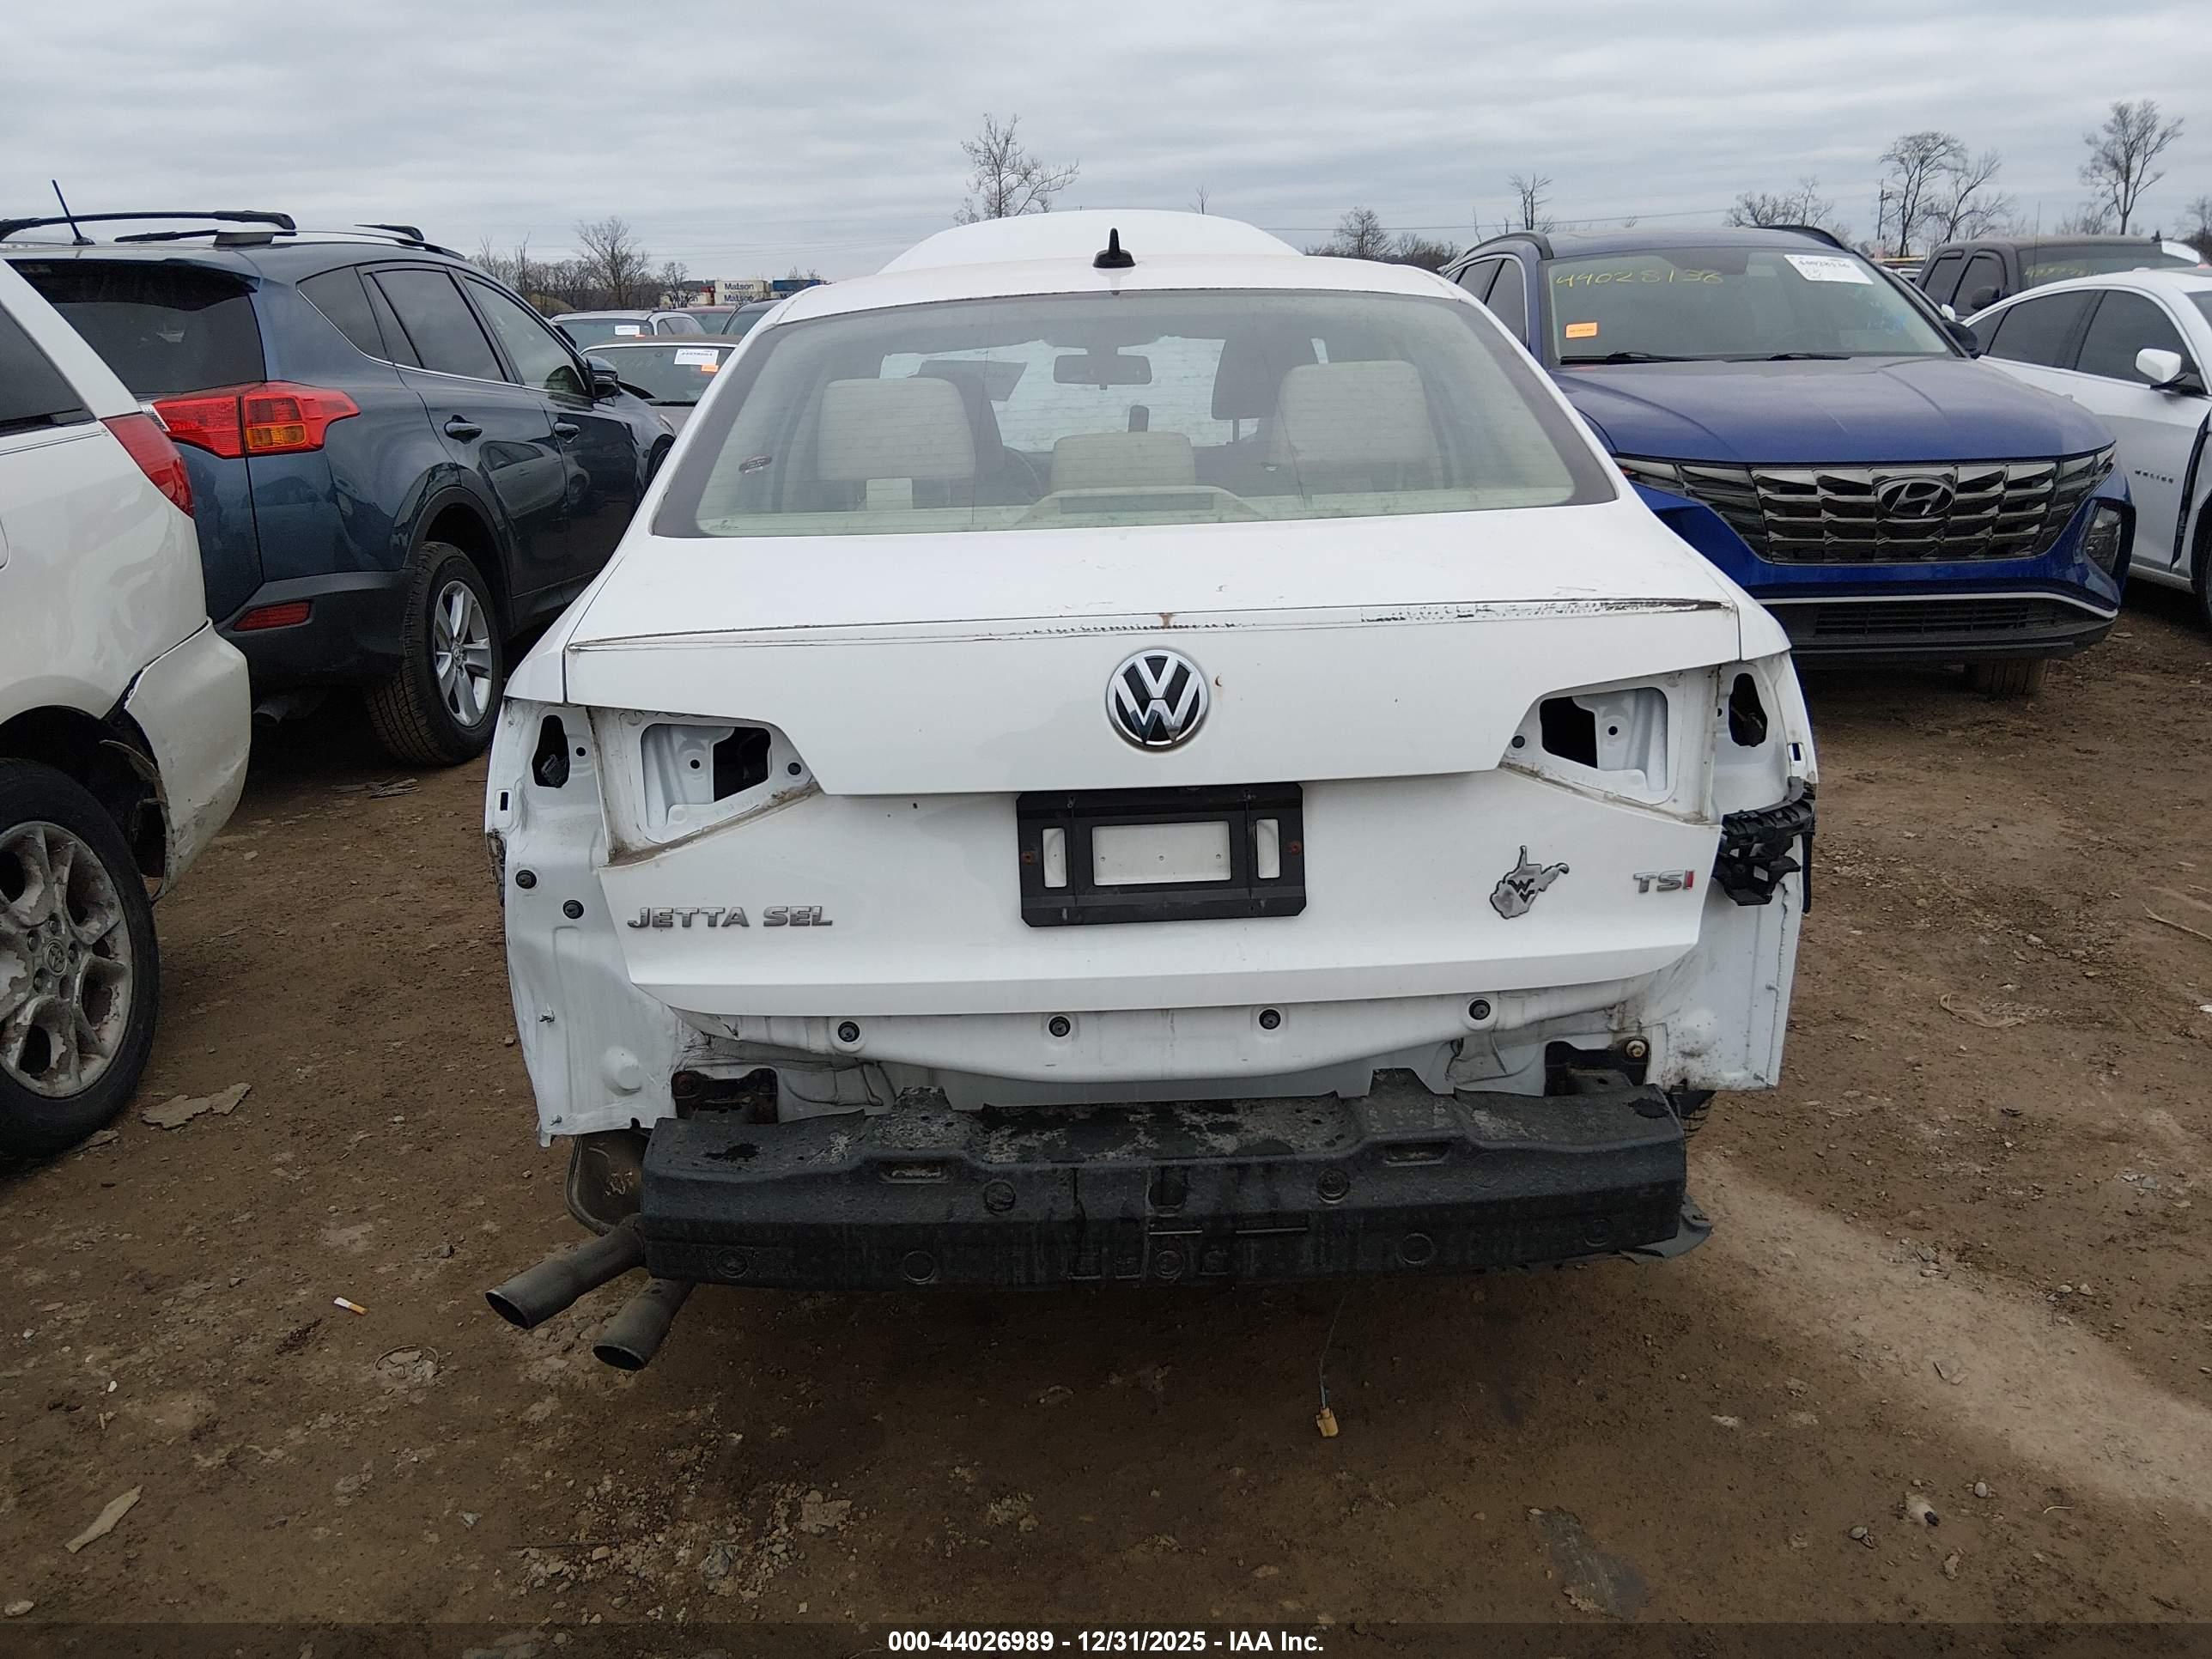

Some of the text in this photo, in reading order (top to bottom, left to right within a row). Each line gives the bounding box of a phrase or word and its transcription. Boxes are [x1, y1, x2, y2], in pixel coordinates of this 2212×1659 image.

[724, 282, 755, 291] Matson
[1632, 869, 1695, 893] TSI
[627, 905, 833, 928] JETTA SEL
